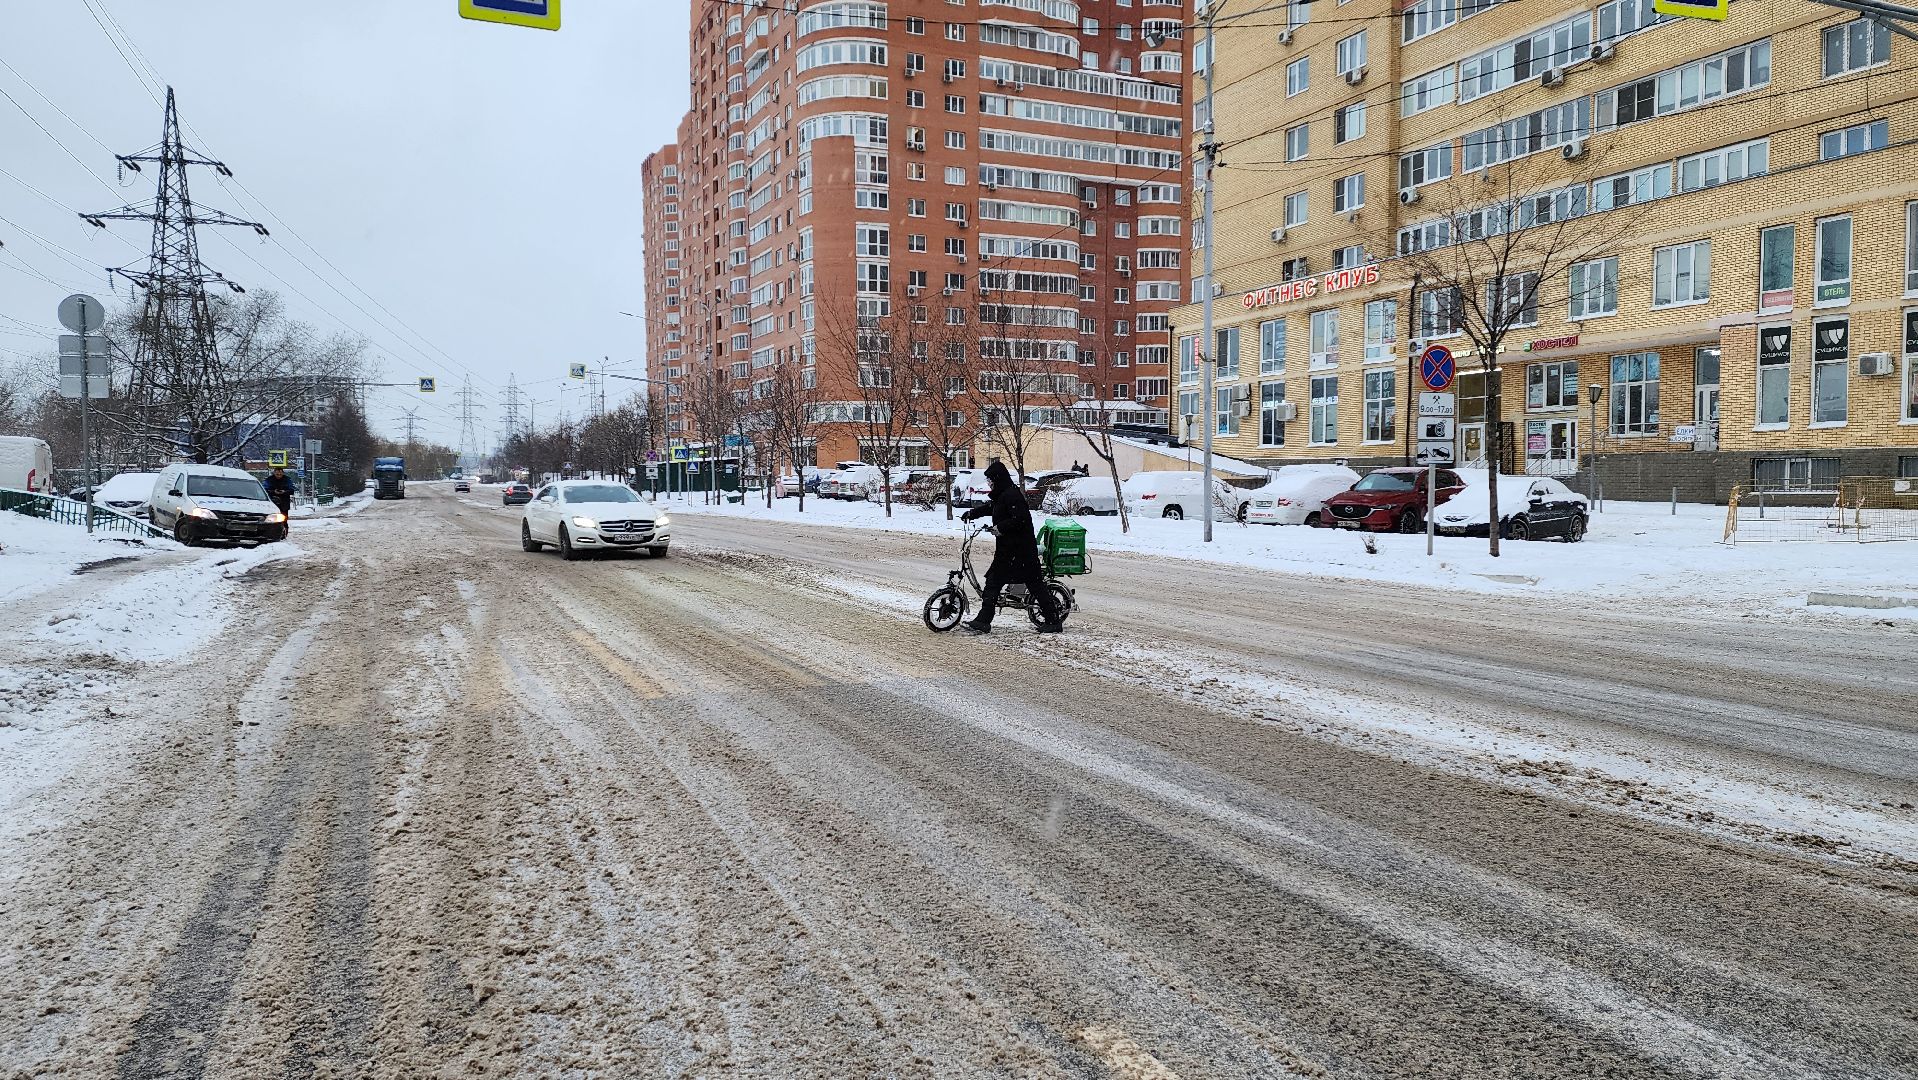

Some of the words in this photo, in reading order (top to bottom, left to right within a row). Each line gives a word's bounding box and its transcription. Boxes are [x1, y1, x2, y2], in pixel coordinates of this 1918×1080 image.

[1242, 278, 1318, 309] ФИТНЕС
[1324, 263, 1380, 293] КЛУБ
[1824, 286, 1846, 297] ОТЕЛЬ
[1531, 335, 1579, 352] ХОСТЕЛ
